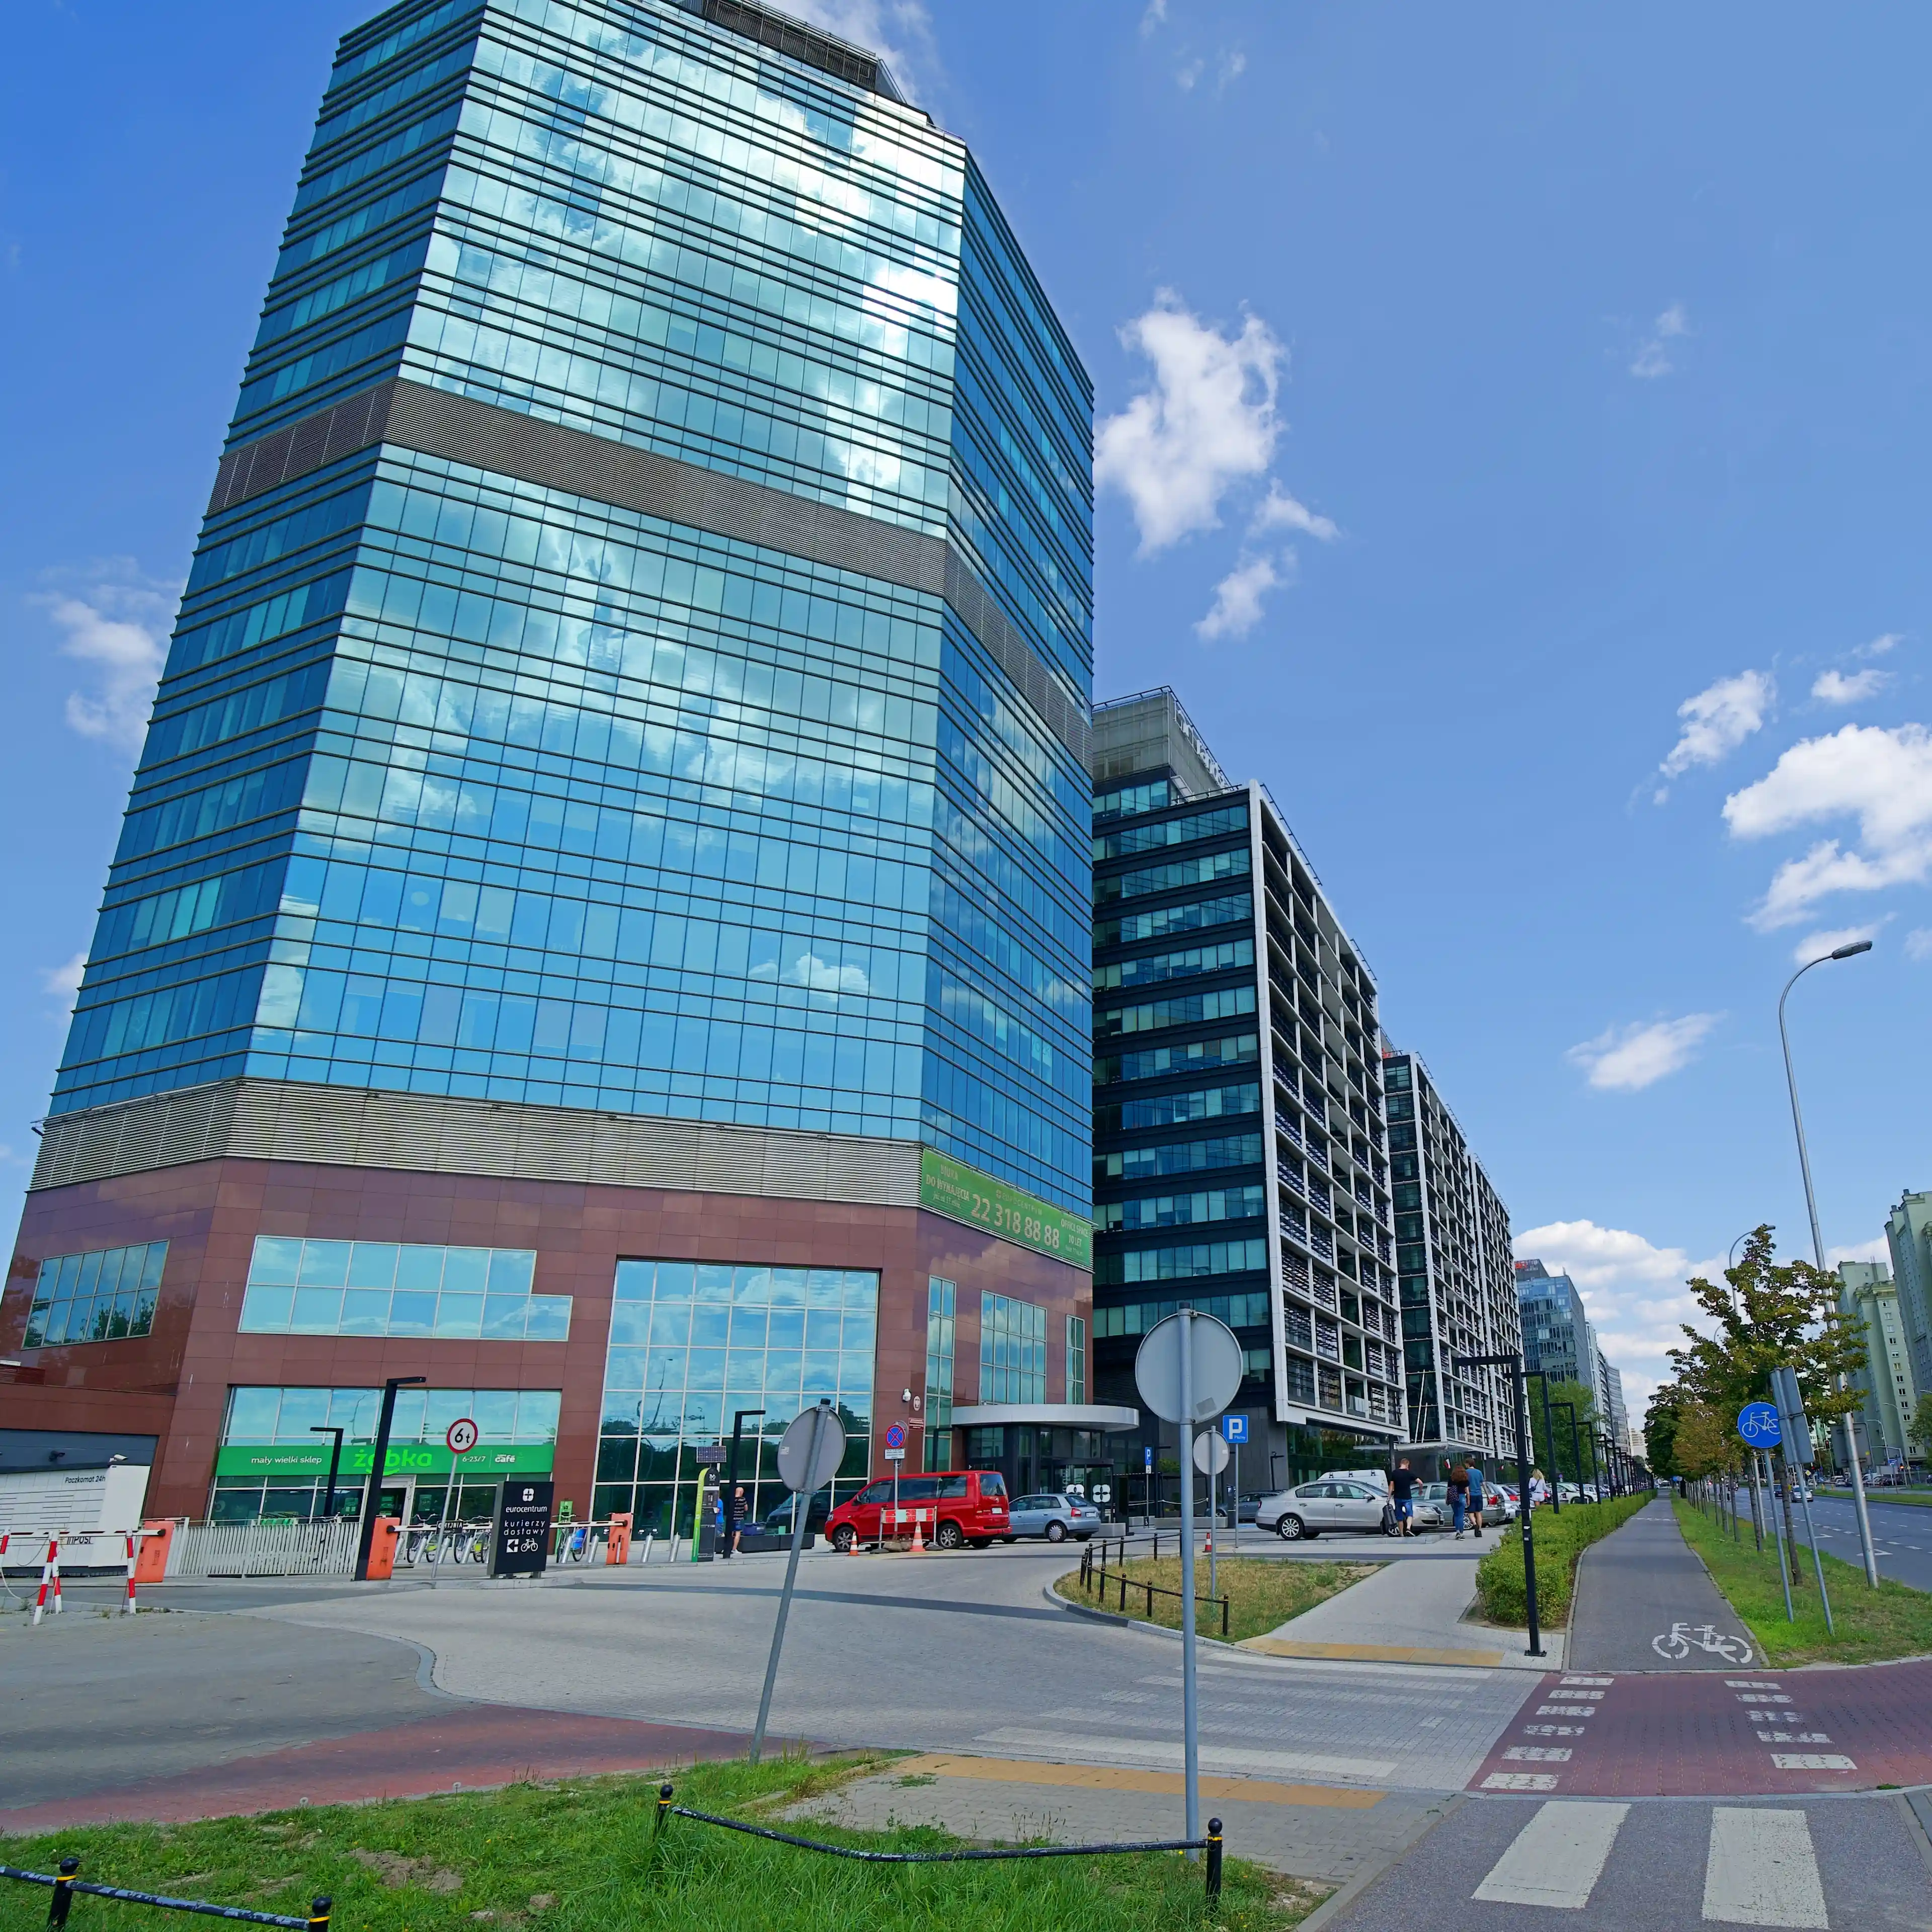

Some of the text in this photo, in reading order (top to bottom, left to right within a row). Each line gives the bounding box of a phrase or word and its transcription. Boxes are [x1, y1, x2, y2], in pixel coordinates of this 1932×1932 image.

[940, 1164, 958, 1181] BIURA
[926, 1174, 936, 1187] DO
[971, 1194, 1060, 1249] 22 318 88 88
[1061, 1218, 1076, 1232] OFFICE
[1229, 1418, 1242, 1439] P
[455, 1428, 470, 1443] 6 t
[251, 1456, 322, 1465] mały wielki sklep
[495, 1455, 515, 1463] café
[1147, 1449, 1151, 1460] P
[65, 1476, 95, 1484] Paczkomat
[504, 1519, 545, 1527] kurierzy
